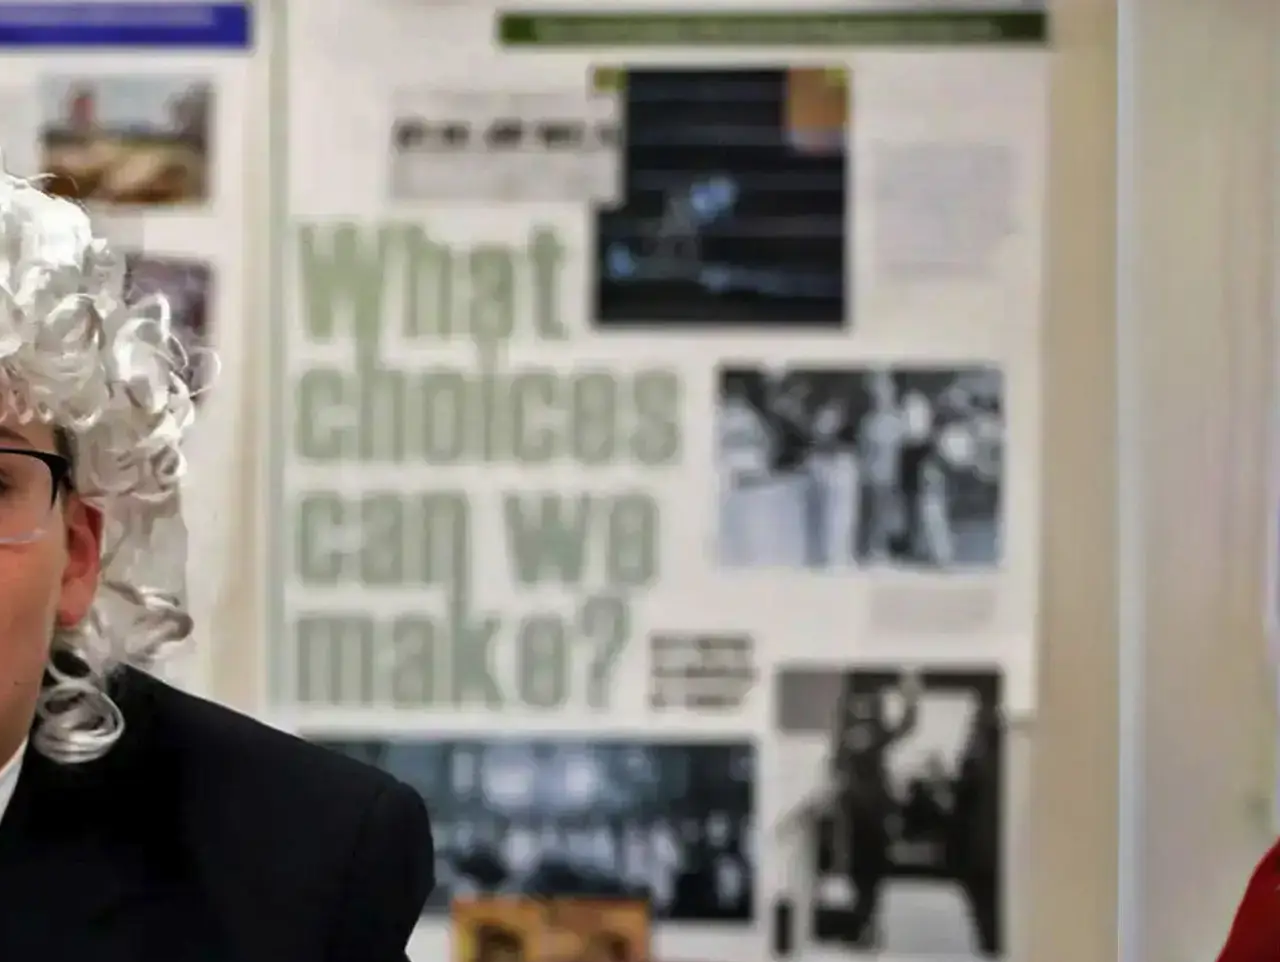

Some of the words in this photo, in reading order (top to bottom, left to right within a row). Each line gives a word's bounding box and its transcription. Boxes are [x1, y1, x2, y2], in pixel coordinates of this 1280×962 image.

[297, 222, 568, 342] What
[295, 345, 680, 464] choices
[297, 491, 468, 588] can
[503, 491, 660, 588] we
[297, 597, 630, 710] make?
